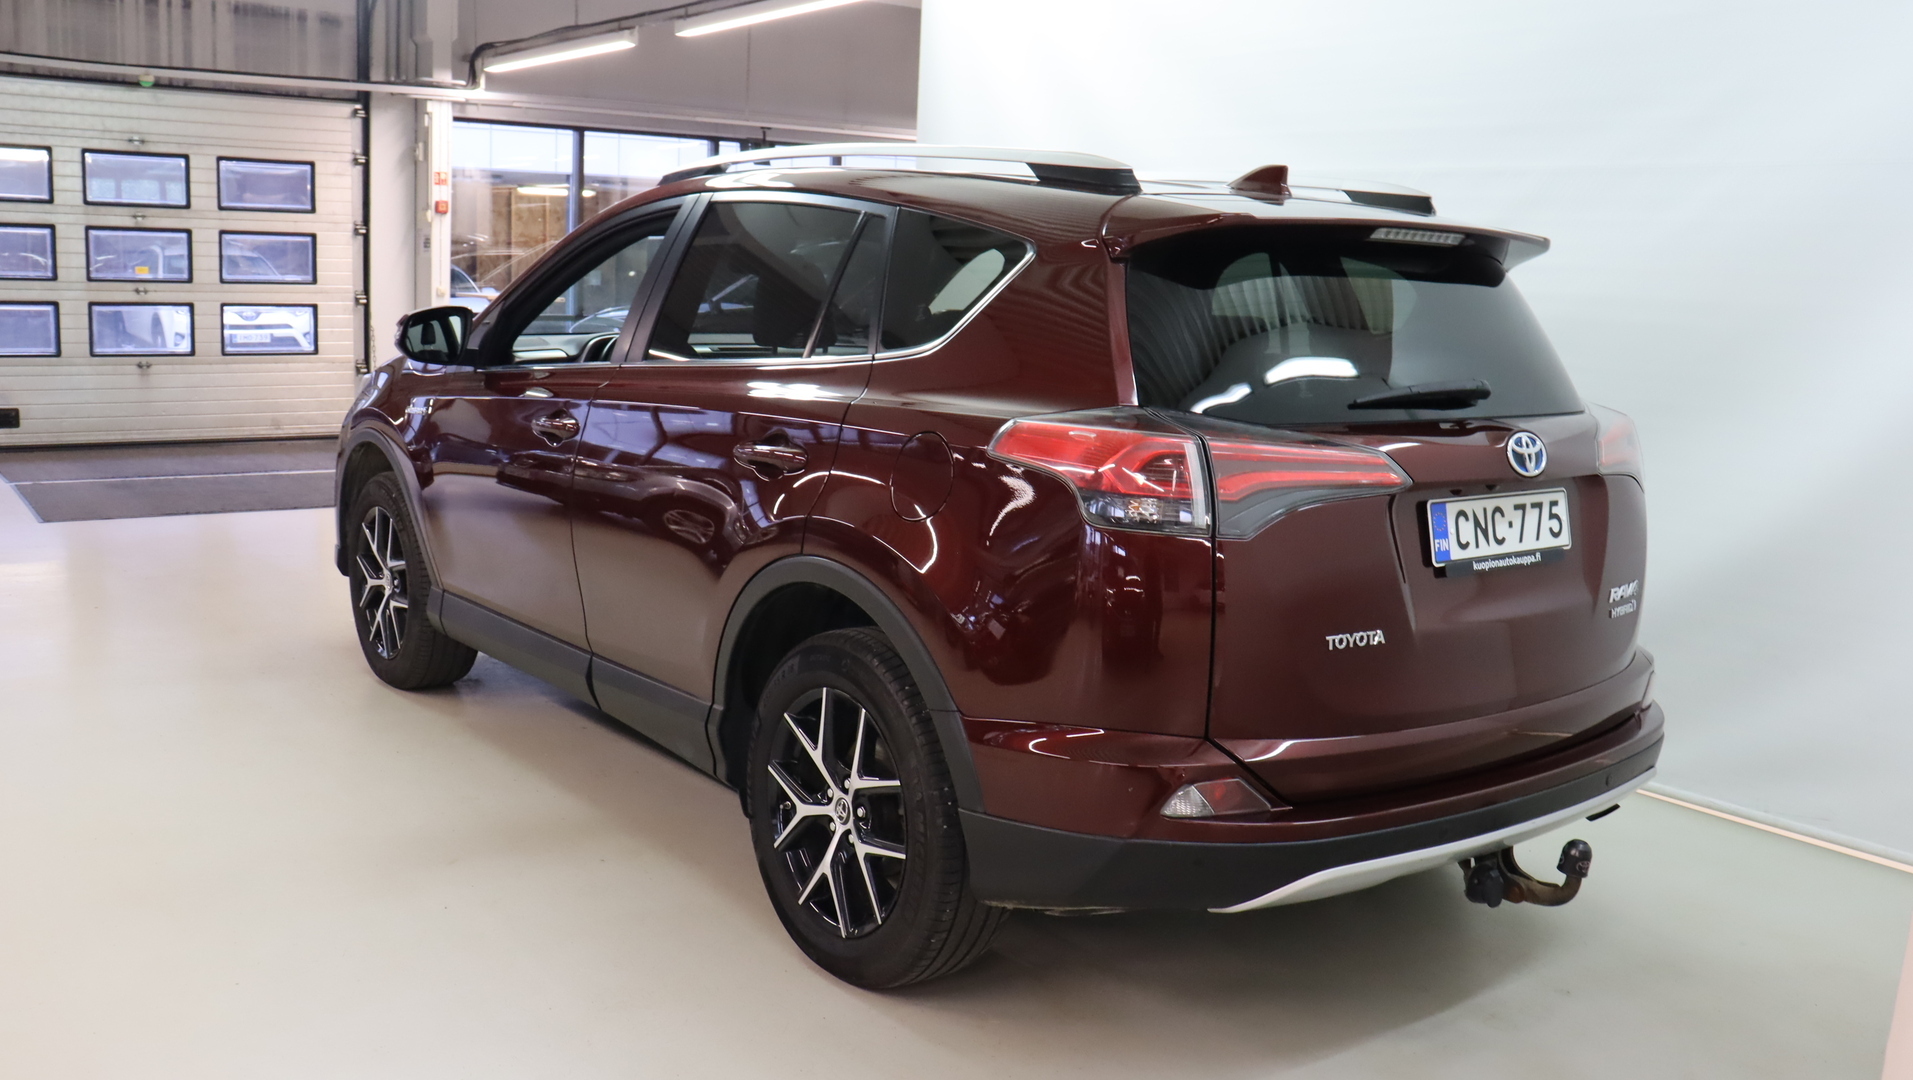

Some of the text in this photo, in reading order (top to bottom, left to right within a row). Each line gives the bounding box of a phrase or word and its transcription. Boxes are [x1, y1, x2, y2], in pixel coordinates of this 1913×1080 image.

[1455, 500, 1563, 550] CNC-775
[1434, 538, 1450, 552] FIN
[1473, 552, 1542, 571] kuopionautokauppa.fi
[1325, 629, 1386, 651] TOYOTA
